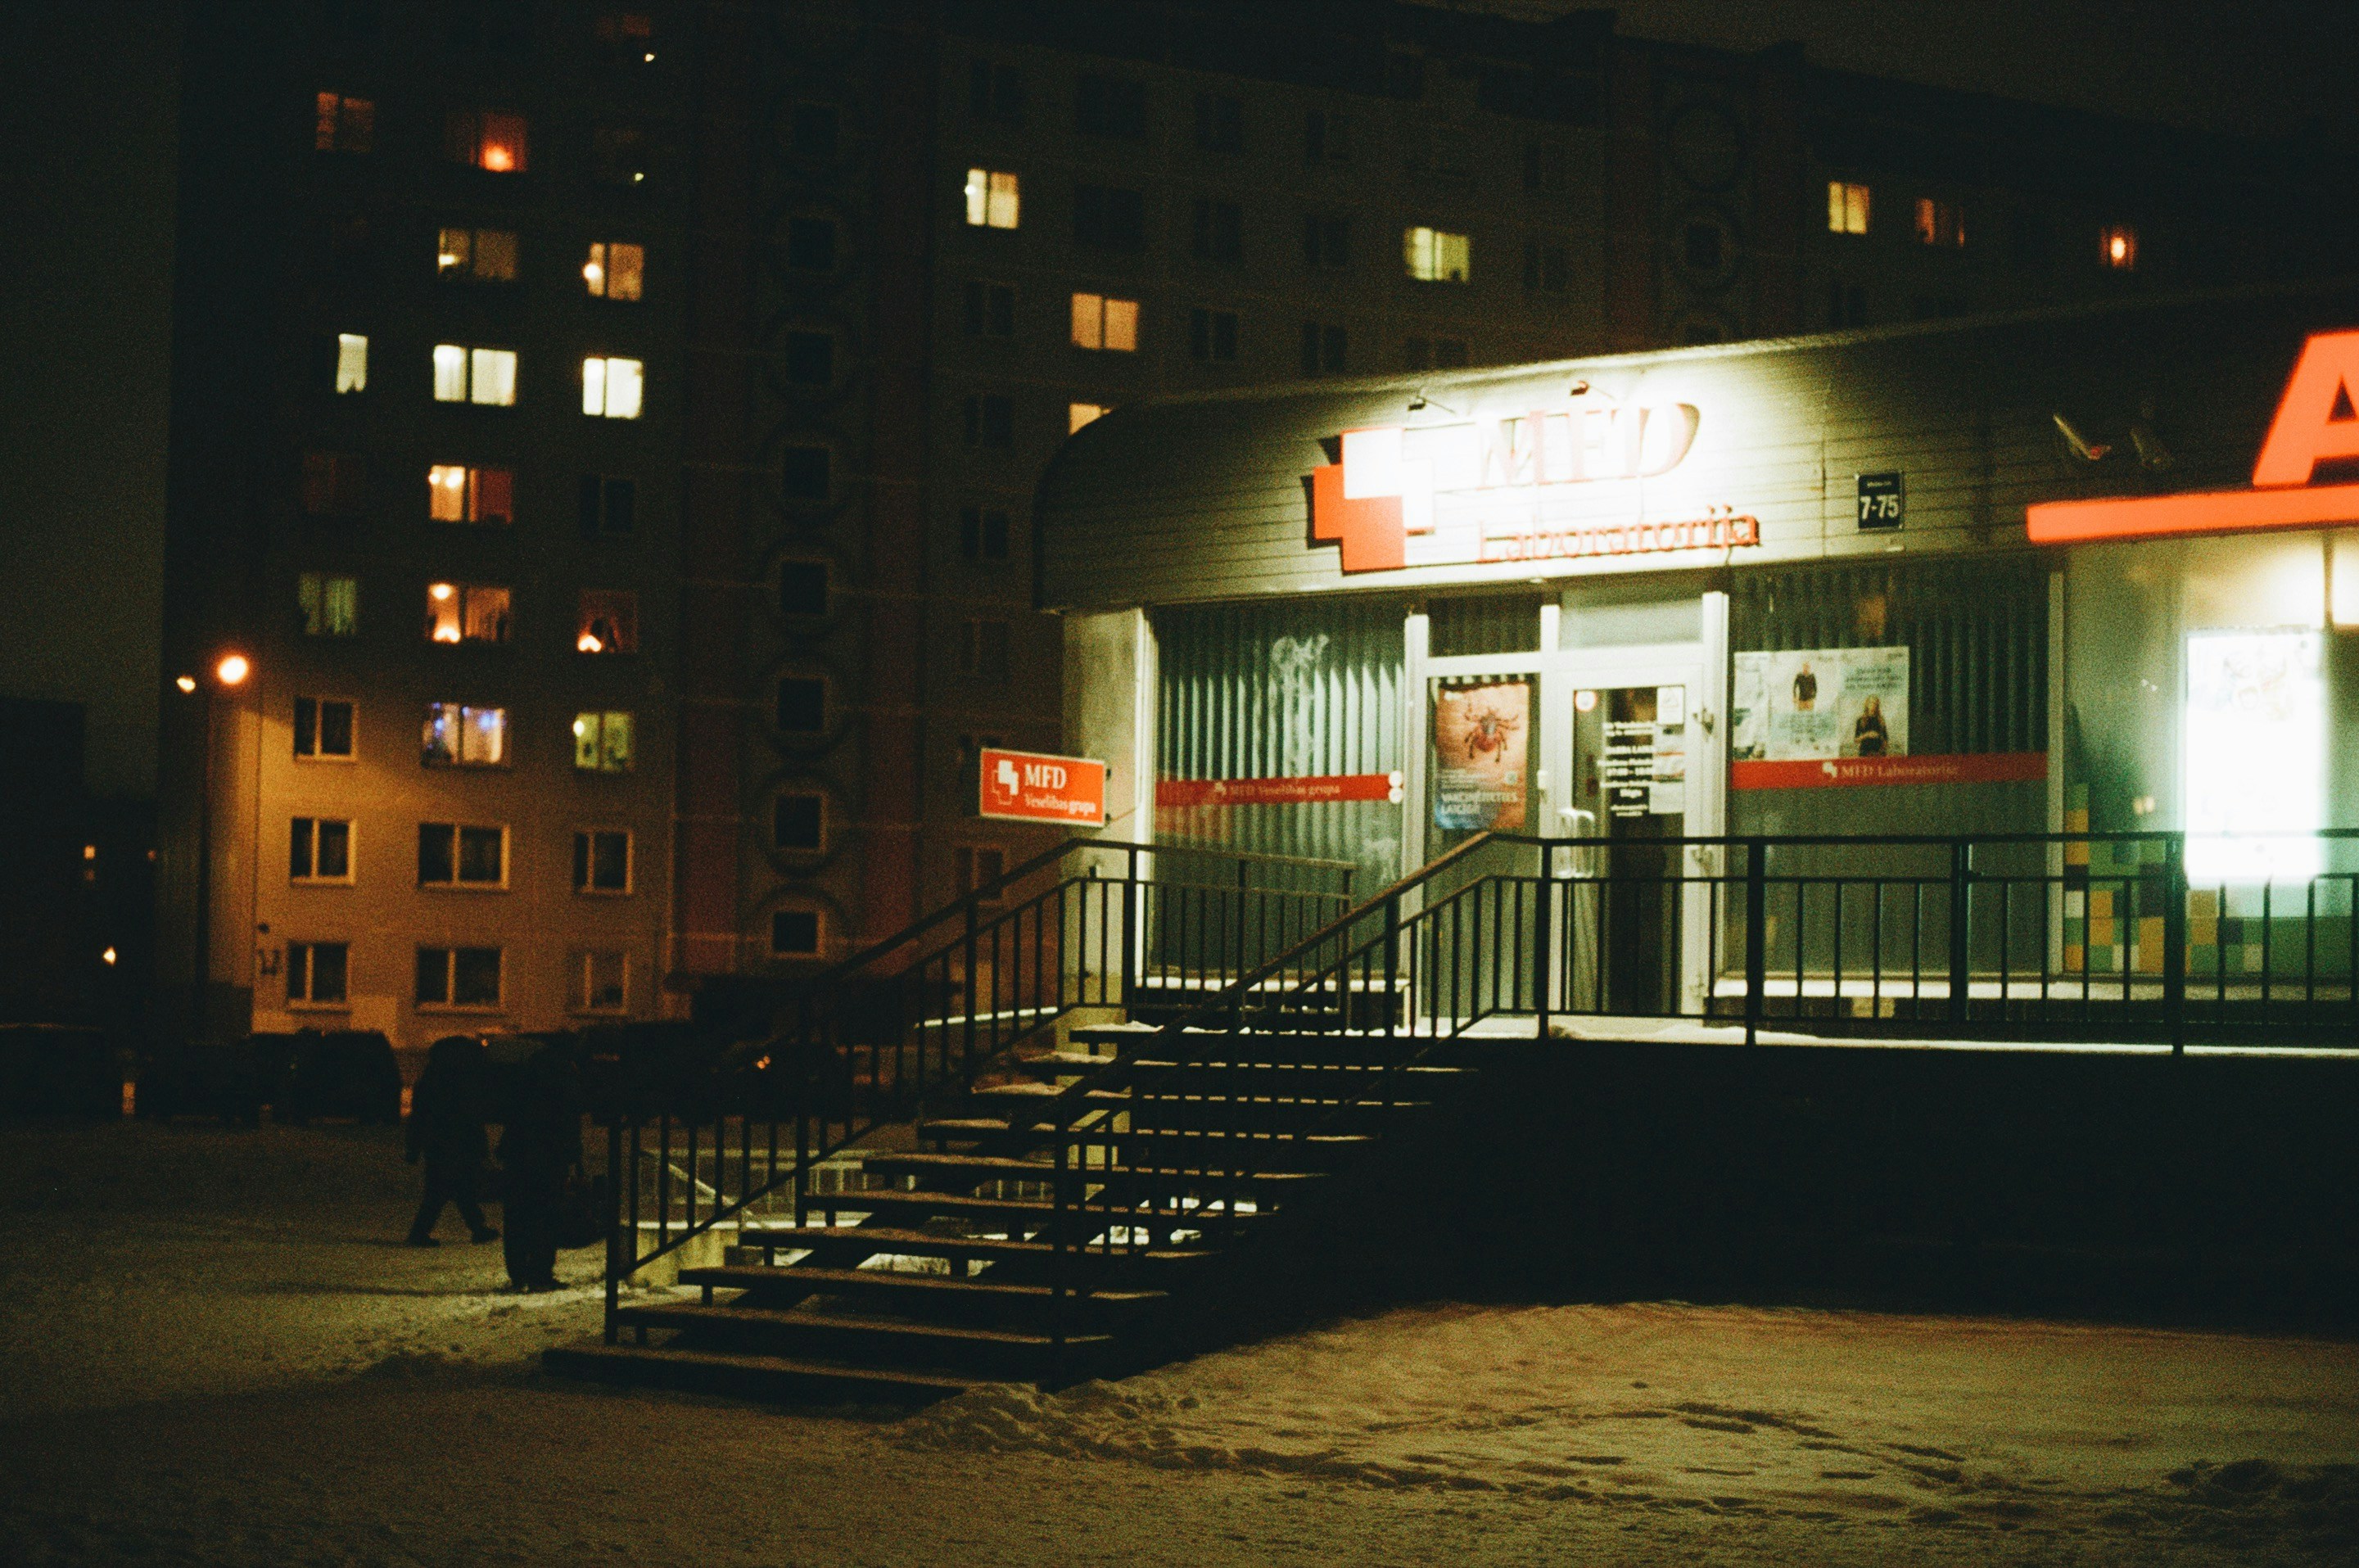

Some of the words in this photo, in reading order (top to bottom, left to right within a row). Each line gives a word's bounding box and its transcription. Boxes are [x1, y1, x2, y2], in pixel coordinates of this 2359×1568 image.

[1474, 402, 1701, 491] MFD
[1860, 494, 1900, 520] 7-75
[1476, 504, 1761, 564] Laboratorija
[1024, 763, 1067, 789] MFD
[1842, 764, 1874, 777] MFD
